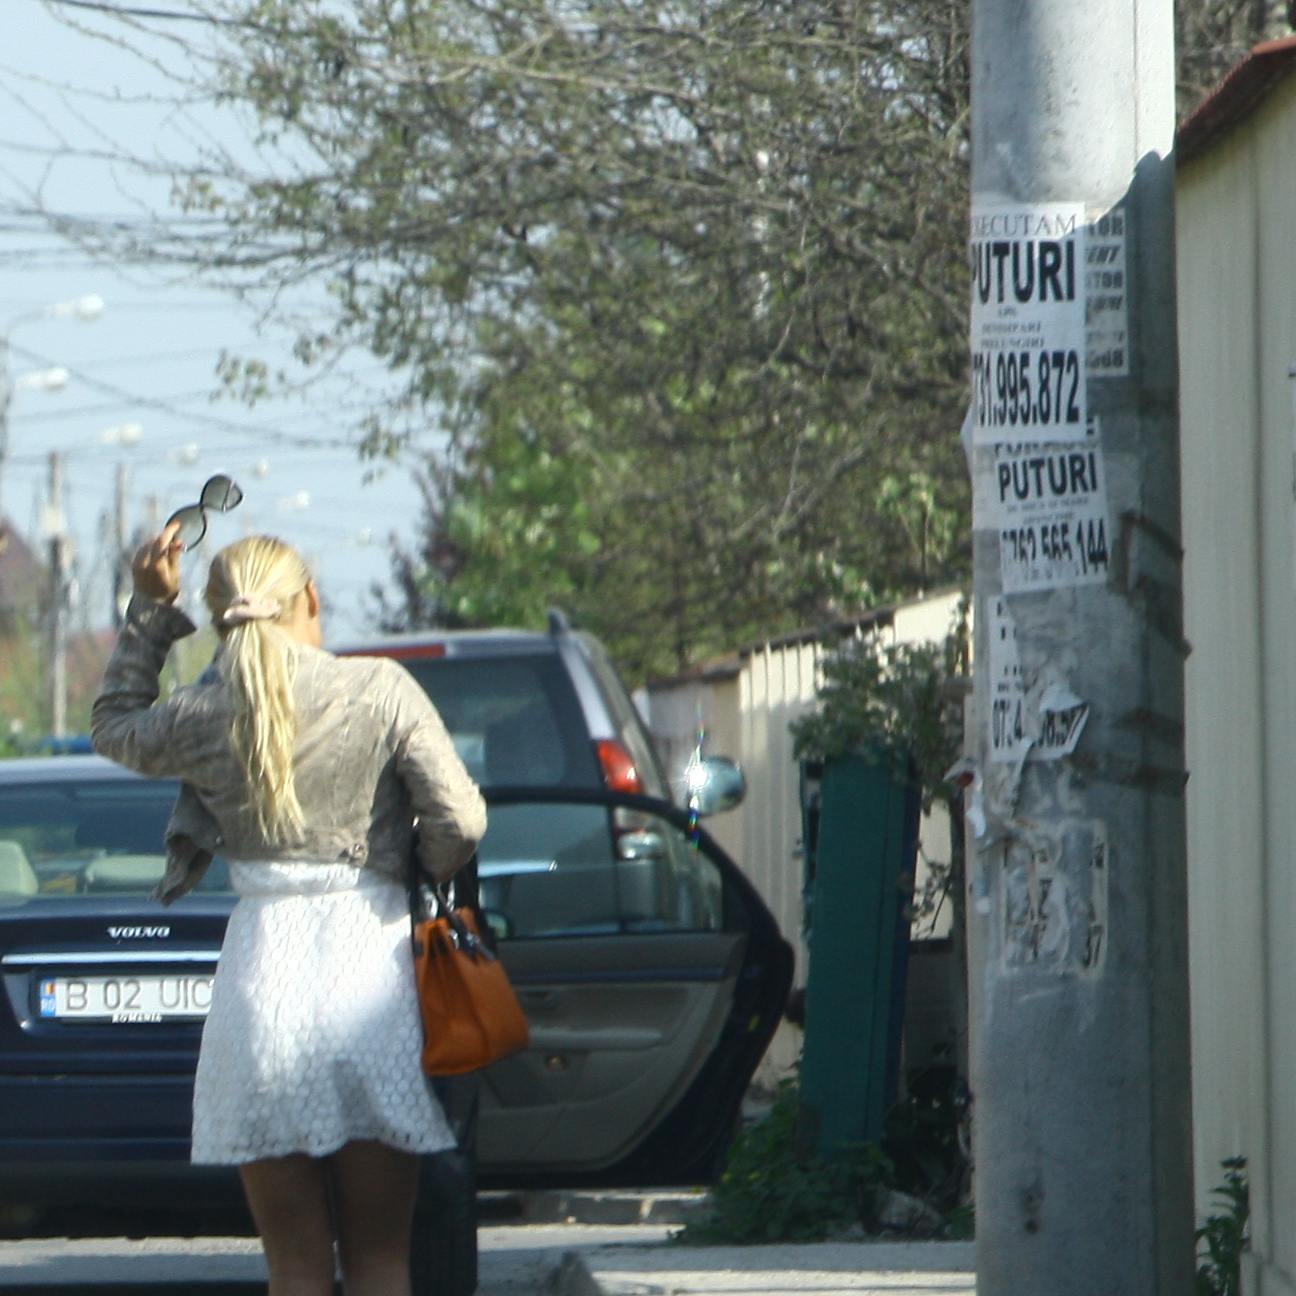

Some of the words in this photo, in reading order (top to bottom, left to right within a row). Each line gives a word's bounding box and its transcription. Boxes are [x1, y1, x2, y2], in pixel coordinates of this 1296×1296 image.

[998, 452, 1098, 502] PUTURI
[107, 926, 170, 938] VOLVO
[66, 982, 89, 1010] B
[104, 979, 142, 1009] 02
